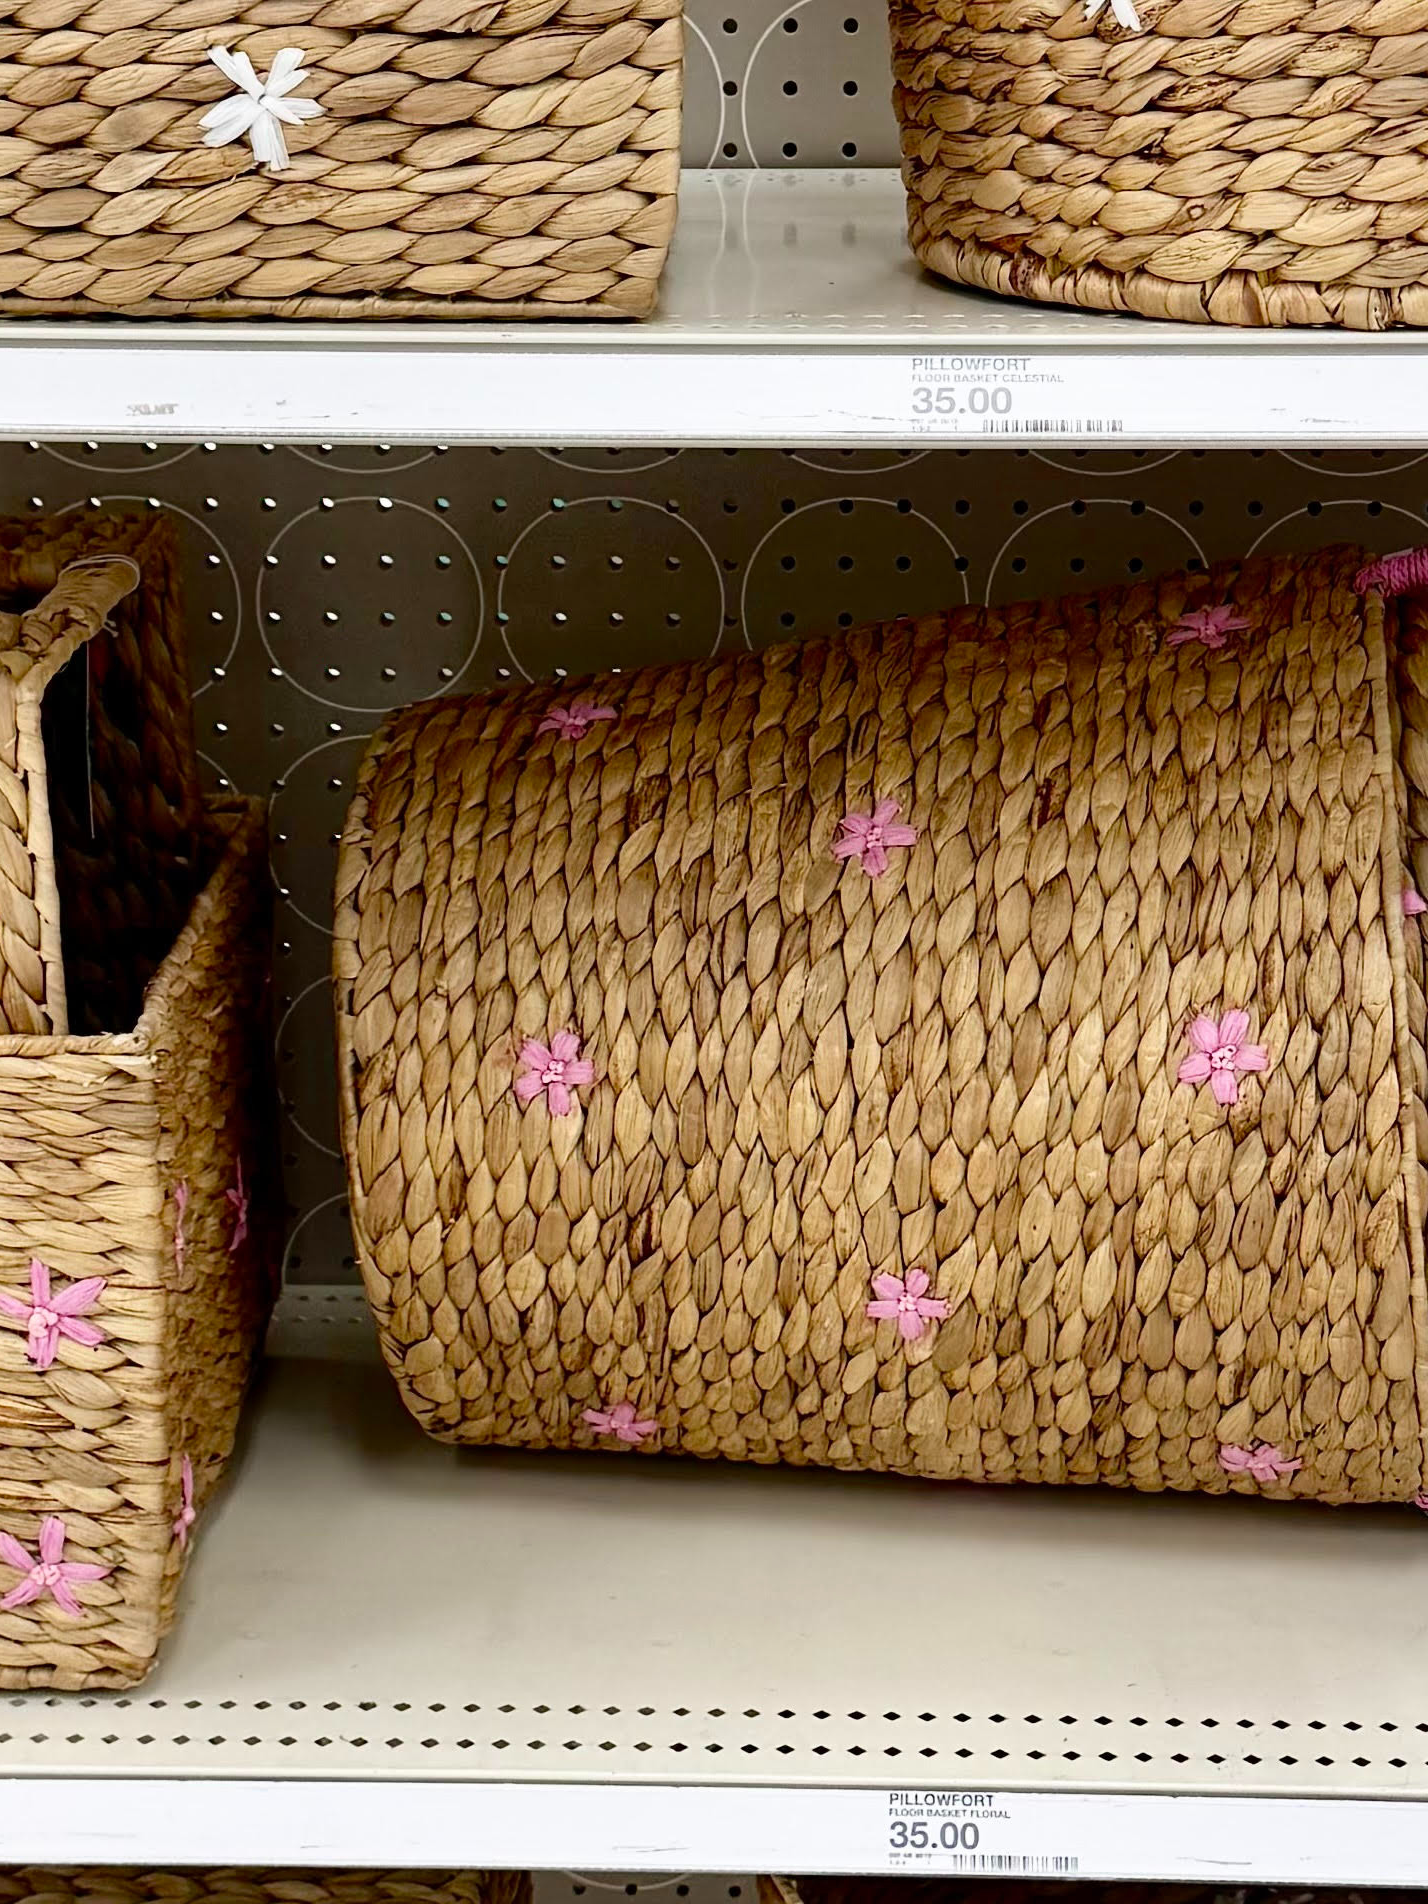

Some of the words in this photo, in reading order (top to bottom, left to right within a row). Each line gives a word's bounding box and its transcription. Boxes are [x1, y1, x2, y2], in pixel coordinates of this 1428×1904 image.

[912, 358, 1031, 371] PILLOWFORT
[912, 374, 950, 383] FLOOR
[954, 374, 998, 383] BASKET
[1002, 374, 1064, 383] CELESTIAL
[912, 387, 1012, 414] 35.00
[889, 1793, 994, 1807] PILLOWFORT
[889, 1808, 924, 1817] FLOOR
[926, 1809, 967, 1818] BASKET
[970, 1809, 1011, 1819] FLORAL
[889, 1821, 979, 1850] 35.00
